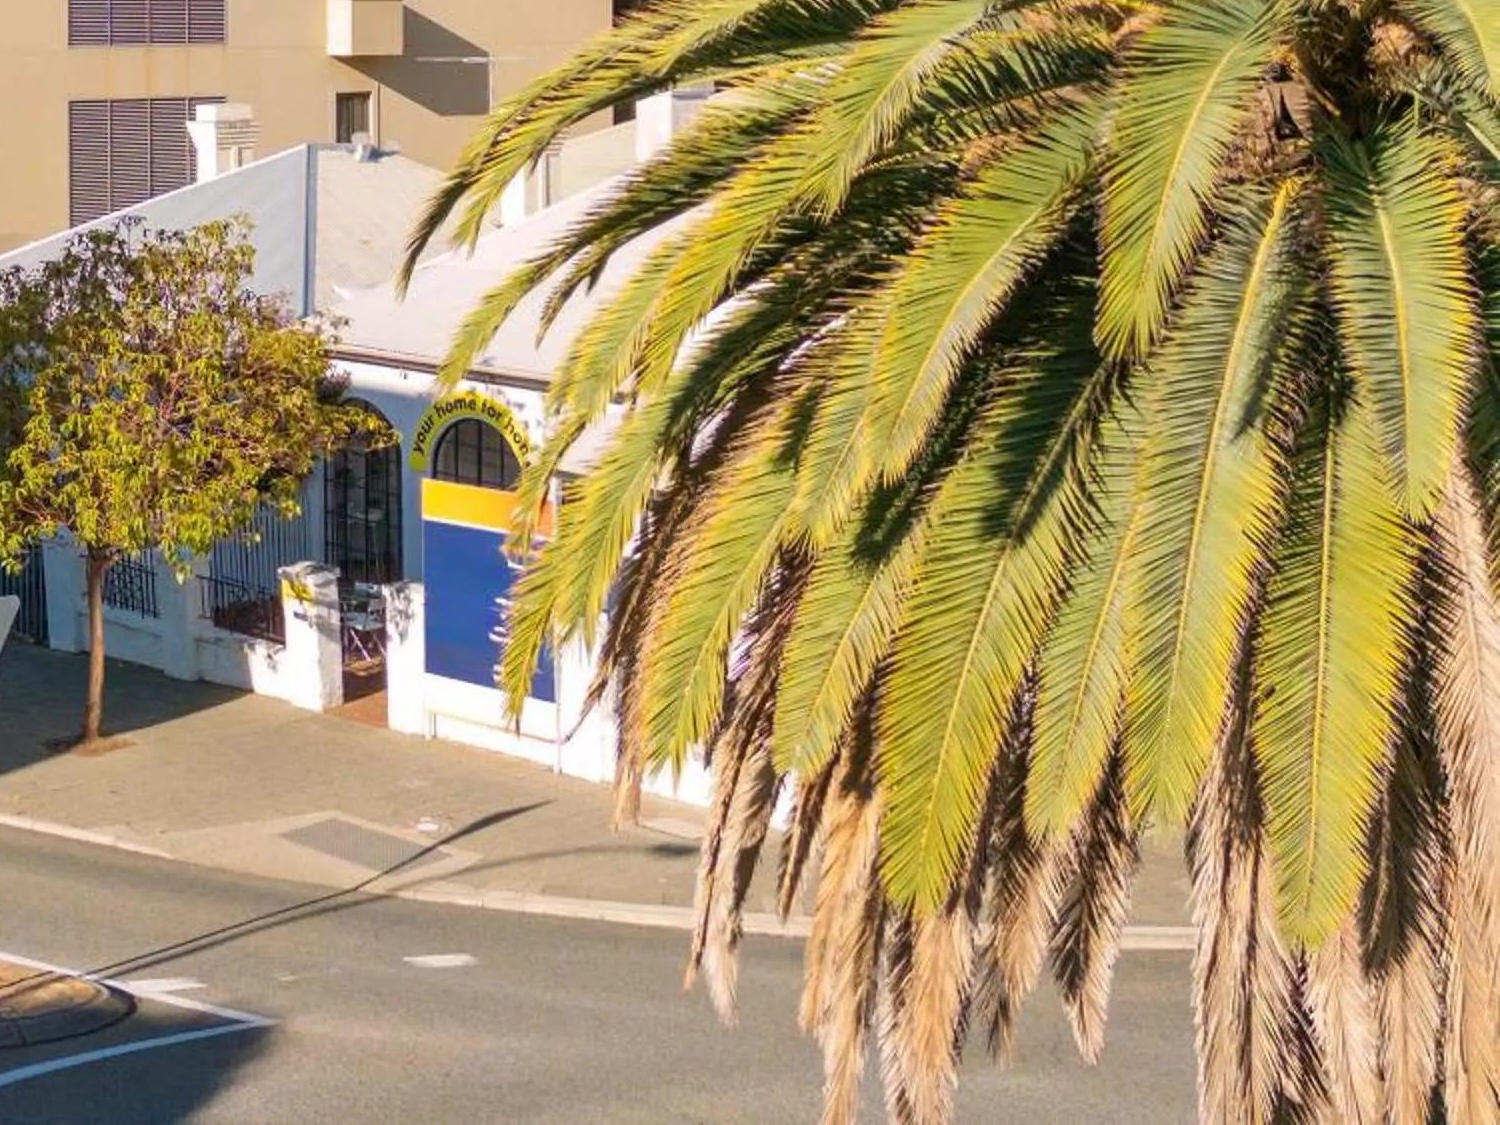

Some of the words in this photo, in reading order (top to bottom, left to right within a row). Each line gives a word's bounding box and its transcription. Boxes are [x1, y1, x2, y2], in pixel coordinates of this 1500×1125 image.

[412, 415, 435, 456] your
[433, 398, 477, 419] home
[481, 399, 503, 421] for
